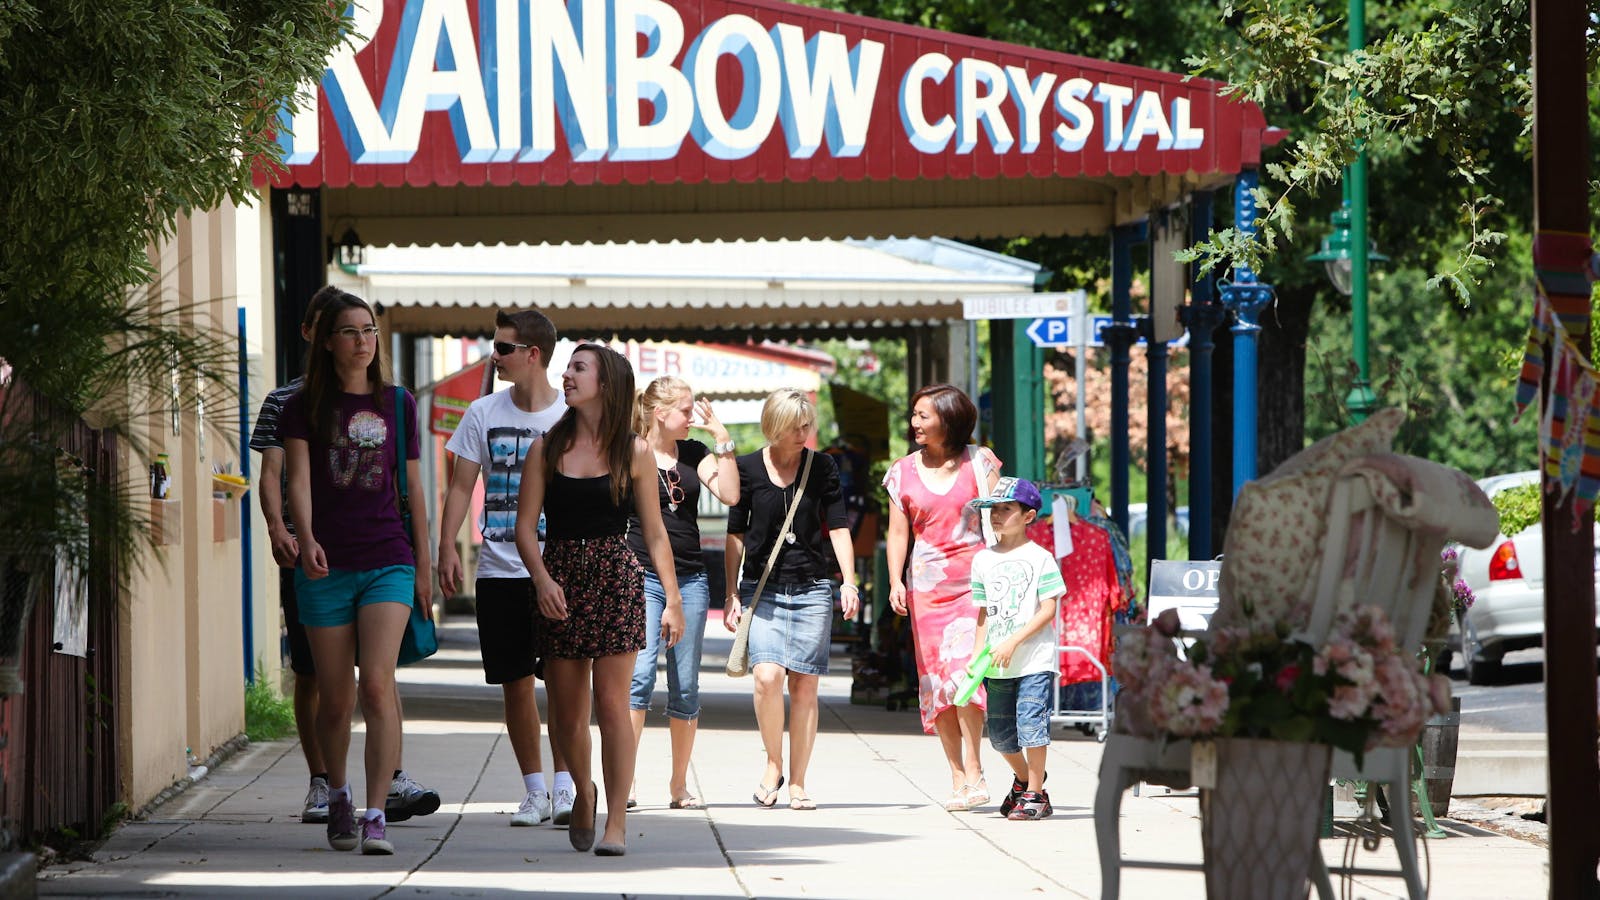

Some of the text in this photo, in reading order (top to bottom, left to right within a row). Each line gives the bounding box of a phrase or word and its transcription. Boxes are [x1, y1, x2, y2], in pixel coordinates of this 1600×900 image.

[281, 0, 1204, 165] RAINBOW CRYSTAL
[967, 296, 1031, 315] JUBILEE
[1048, 320, 1066, 341] P
[624, 342, 682, 374] ER
